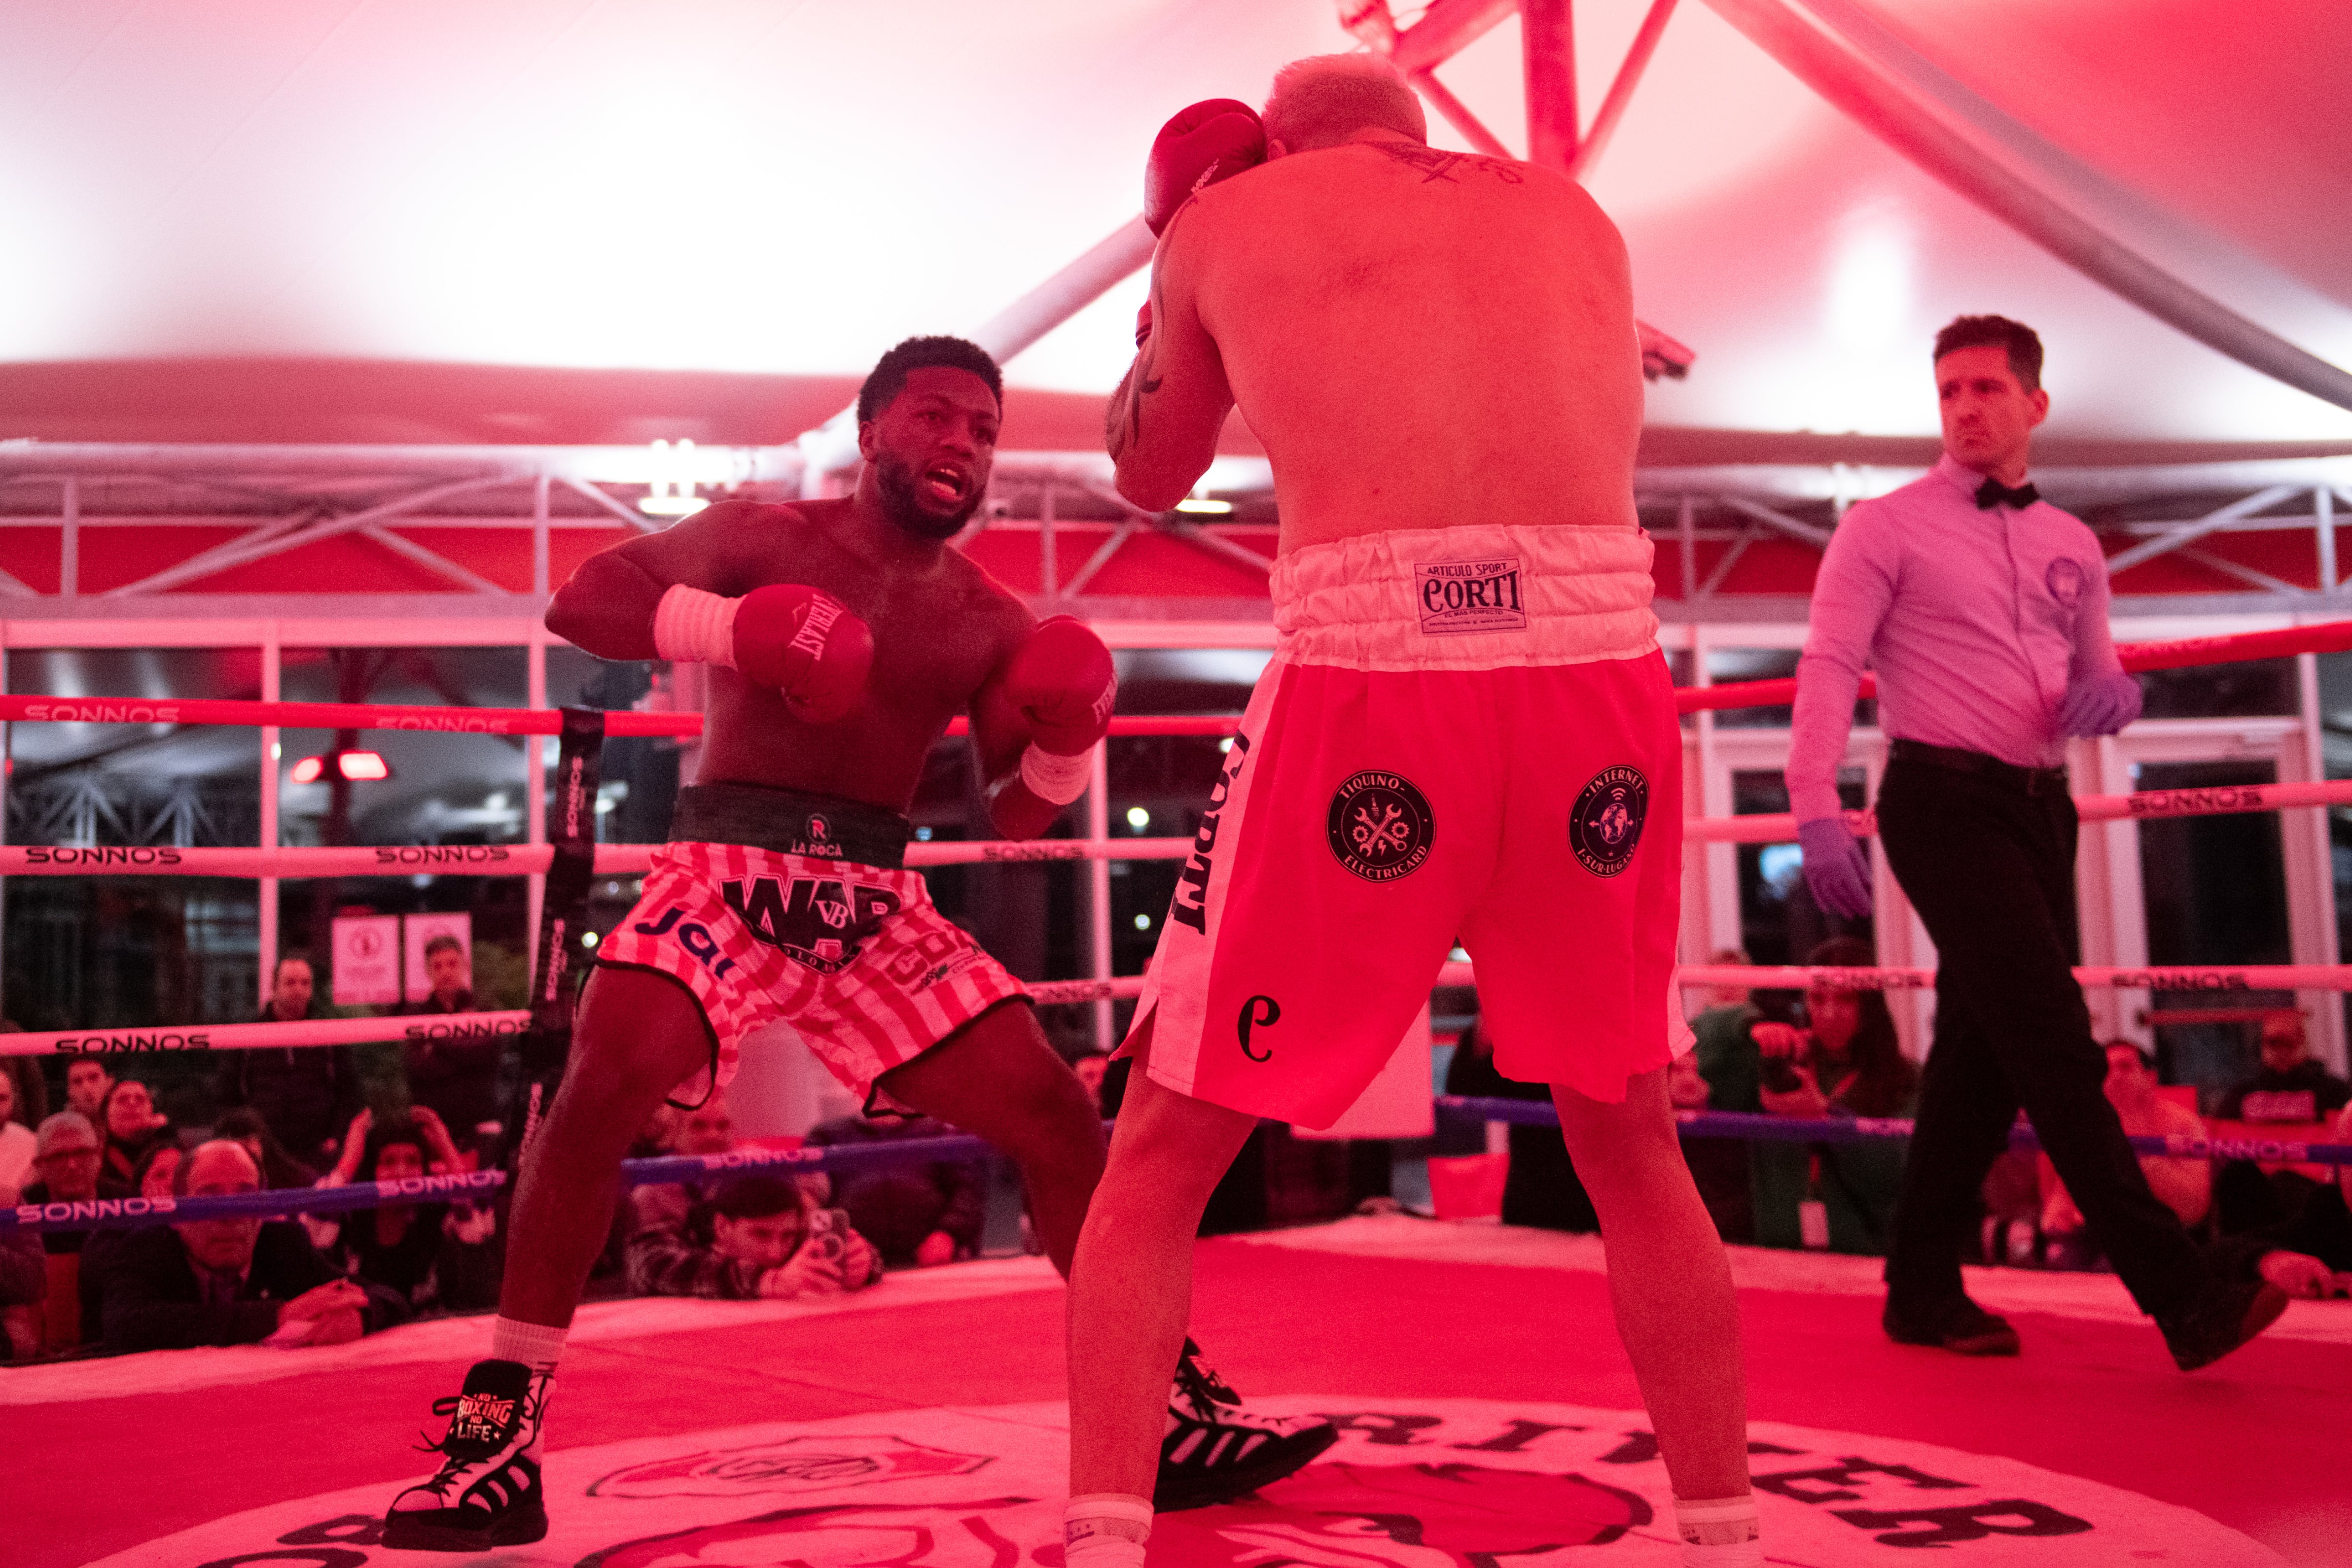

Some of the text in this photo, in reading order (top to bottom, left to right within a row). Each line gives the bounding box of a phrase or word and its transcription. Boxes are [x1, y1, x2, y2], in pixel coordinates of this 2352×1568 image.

[1427, 562, 1507, 577] ARTICULO SPORT
[25, 705, 180, 724] SONNOS
[1589, 769, 1644, 793] INTERNET
[812, 819, 826, 839] R
[26, 847, 182, 866] SONNOS
[376, 846, 510, 864] SONNOS
[790, 838, 843, 857] LA ROCA
[1344, 845, 1427, 879] ELECTRICARD
[815, 900, 849, 929] VB
[56, 1035, 211, 1054] SONNOS
[16, 1197, 177, 1224] SONNOS
[478, 1393, 492, 1402] NO
[458, 1399, 513, 1424] BOXING
[469, 1416, 483, 1424] NO
[457, 1422, 492, 1443] LIFE
